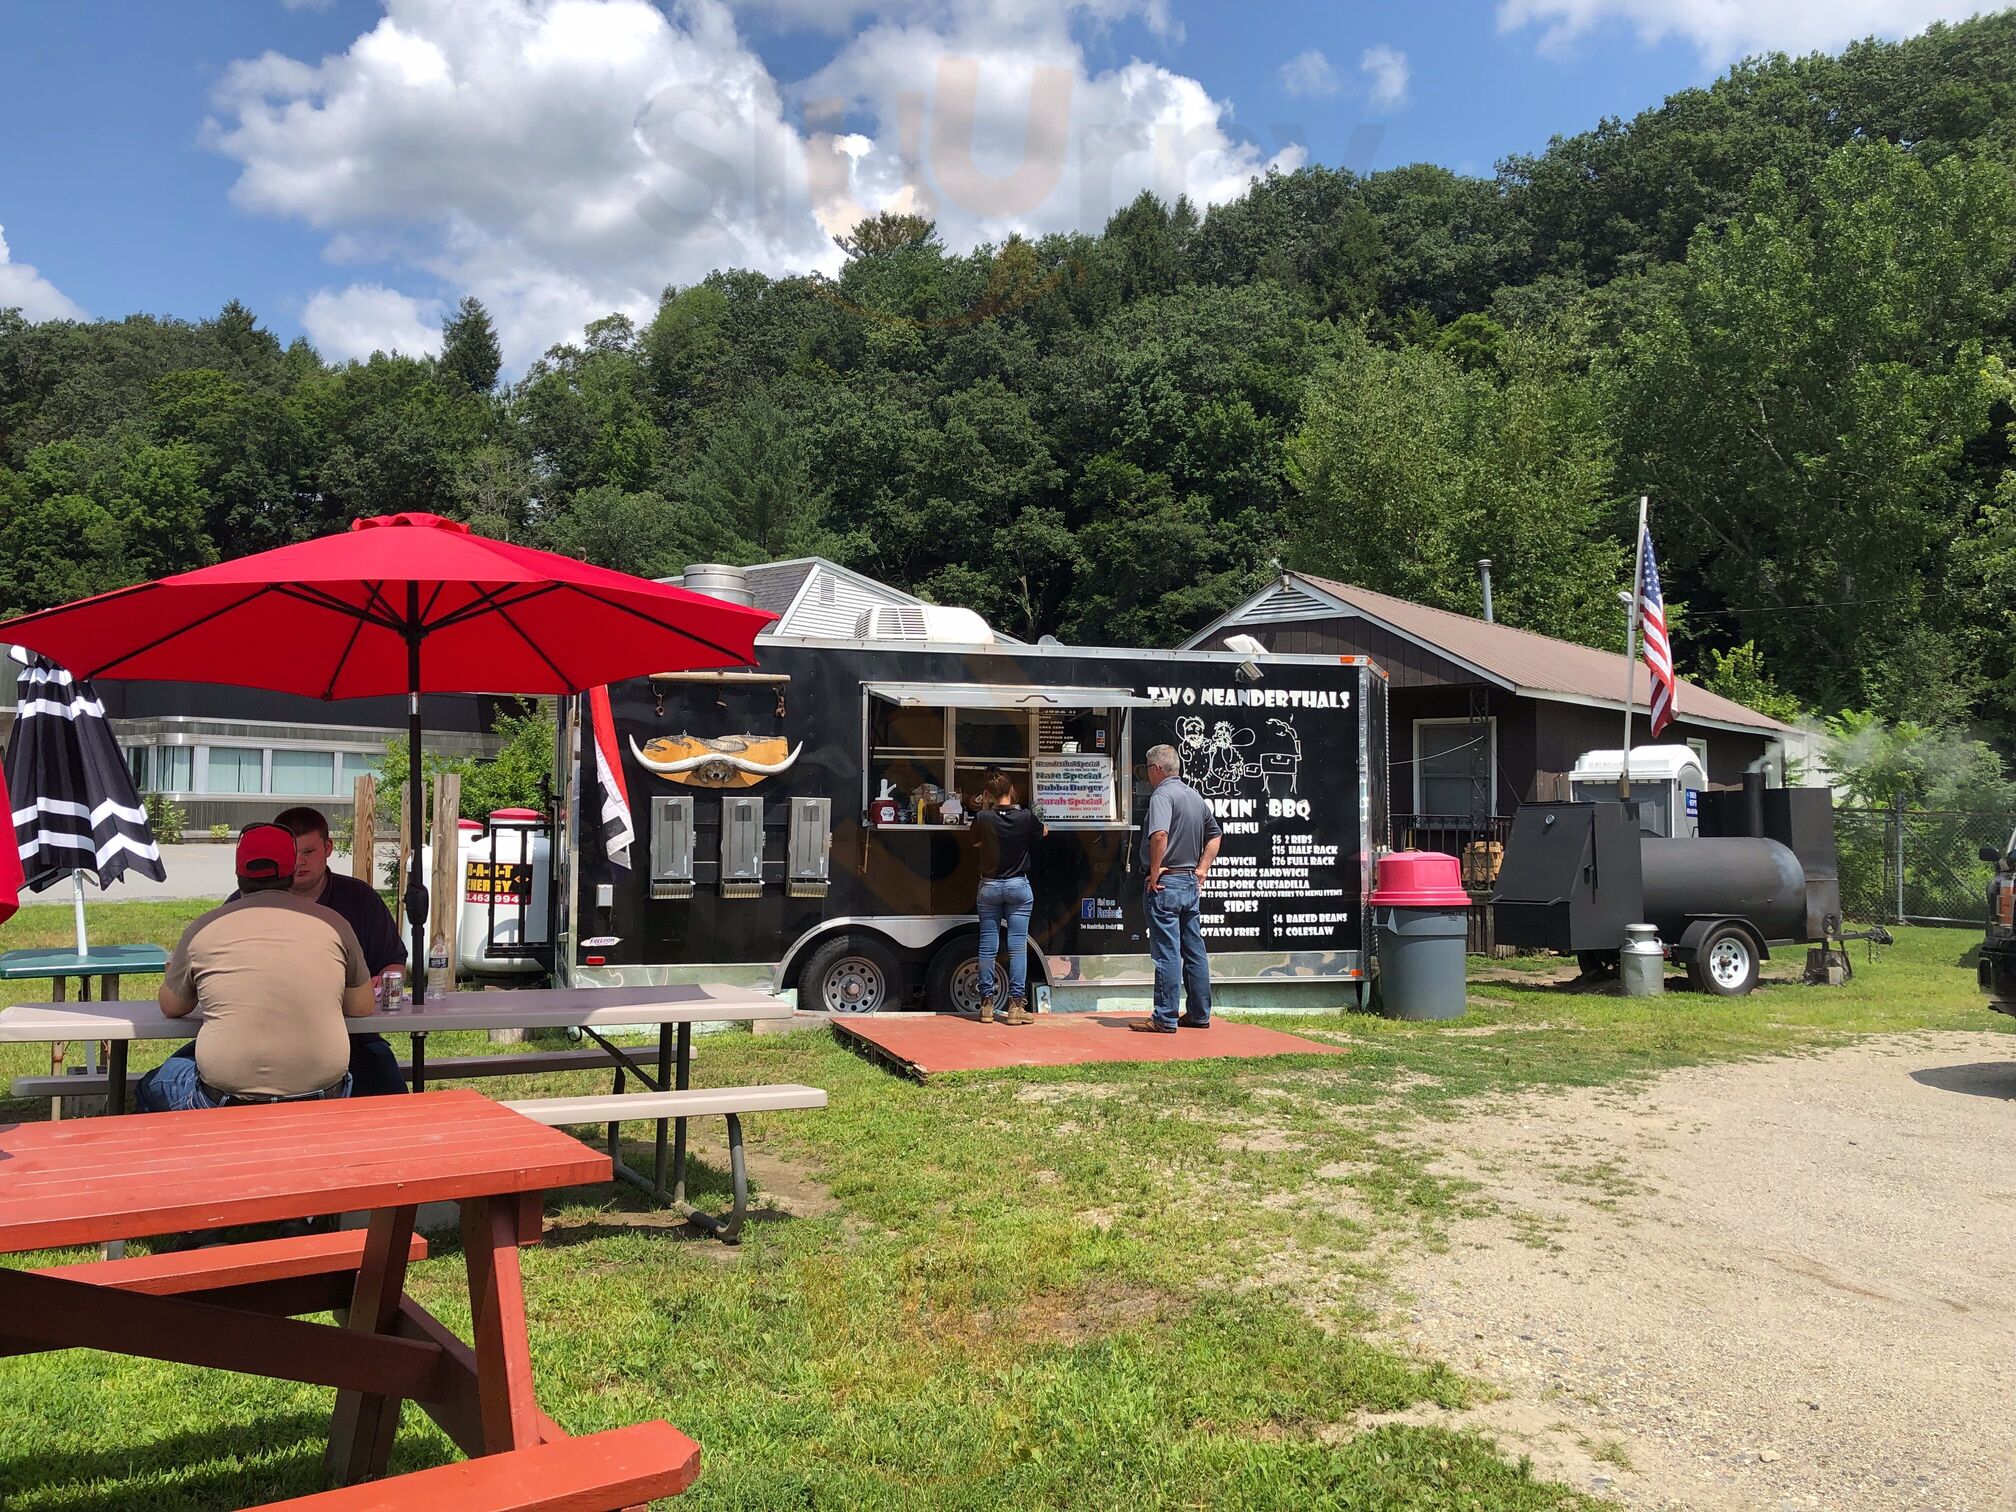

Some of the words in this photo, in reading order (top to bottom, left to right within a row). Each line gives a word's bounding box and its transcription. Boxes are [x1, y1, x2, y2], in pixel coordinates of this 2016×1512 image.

[1147, 686, 1196, 706] TWO
[1200, 687, 1350, 709] NEANDERTHALS
[1035, 772, 1061, 780] Nate
[1062, 772, 1102, 781] Special
[1037, 784, 1069, 792] Bubba
[1069, 784, 1104, 793] Burger
[1036, 797, 1066, 806] Sarah
[1067, 797, 1103, 806] Special
[1268, 798, 1311, 821] BBQ
[1222, 821, 1259, 835] MENU
[1271, 834, 1282, 845] $5
[1284, 834, 1290, 844] 2
[1291, 834, 1313, 844] RIBS
[1271, 845, 1286, 855] $15
[1288, 845, 1313, 855] HALF
[1313, 845, 1339, 855] RACK
[1210, 856, 1257, 866] ANDWICH
[1271, 856, 1286, 866] $26
[1286, 856, 1310, 866] FULL
[1310, 856, 1336, 866] RACK
[1231, 867, 1258, 878] PORK
[1258, 867, 1309, 878] SANDWICH
[467, 879, 512, 892] ENERGY
[1229, 879, 1256, 890] PORK
[1256, 879, 1311, 891] QUESADILLA
[1214, 890, 1228, 898] FOR
[1229, 890, 1251, 898] SWEET
[1251, 890, 1277, 898] POTATO
[1277, 889, 1295, 898] FRIES
[1295, 889, 1304, 897] TO
[1305, 889, 1323, 897] MENU
[1323, 888, 1343, 897] ITEMS
[1224, 900, 1259, 912] SIDES
[1200, 914, 1225, 924] FRIES
[1272, 913, 1283, 924] $4
[1285, 913, 1318, 923] BAKED
[1318, 912, 1348, 923] BEANS
[1200, 927, 1233, 937] OTATO
[1233, 927, 1260, 937] FRIES
[1273, 926, 1283, 937] $3
[1285, 926, 1335, 937] COLESLAW
